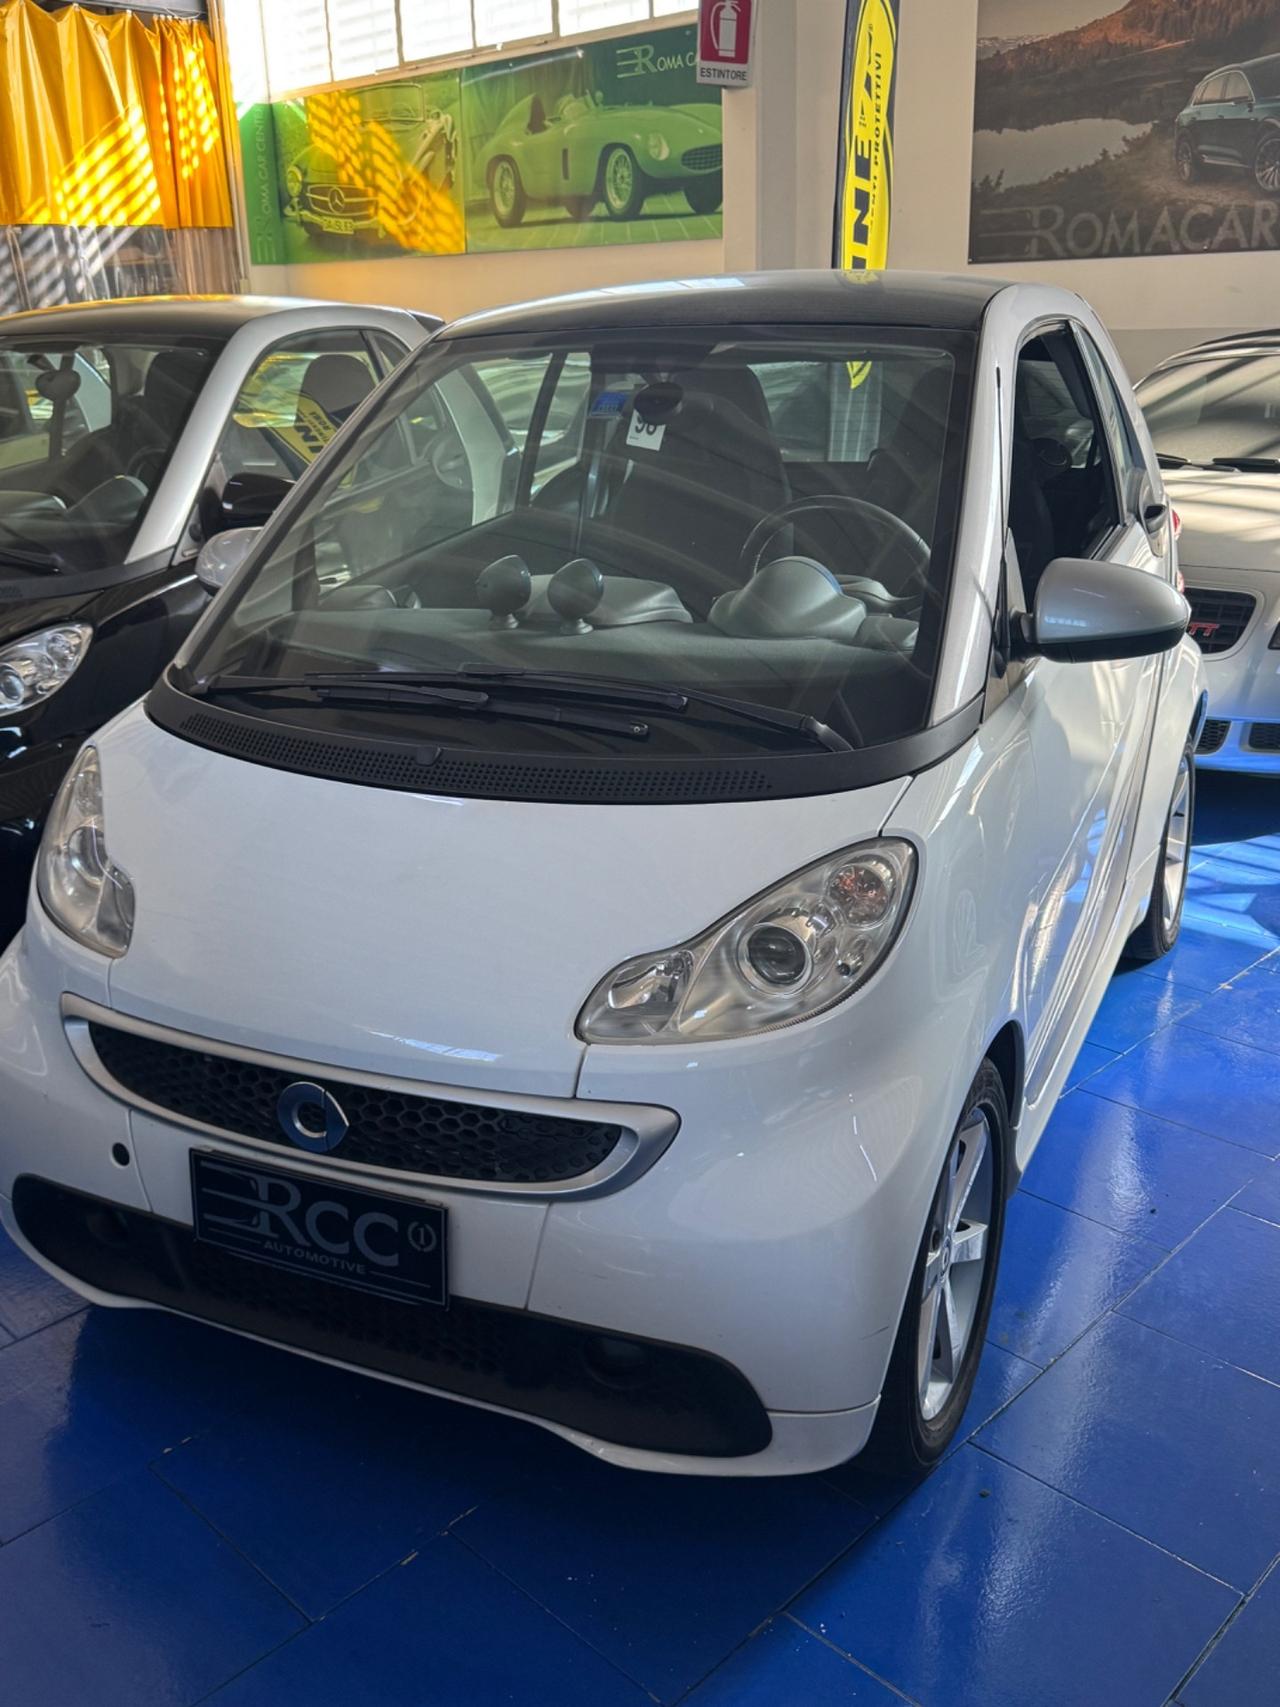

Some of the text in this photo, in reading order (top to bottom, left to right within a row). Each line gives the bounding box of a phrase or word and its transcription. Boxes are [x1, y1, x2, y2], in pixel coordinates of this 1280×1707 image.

[615, 44, 697, 78] ROMA C
[700, 67, 747, 81] ESTINTORE
[257, 155, 269, 180] CAR
[979, 200, 1280, 259] ROMACAR
[201, 1160, 399, 1267] RCC
[264, 1240, 366, 1275] AUTOMOTIVE
